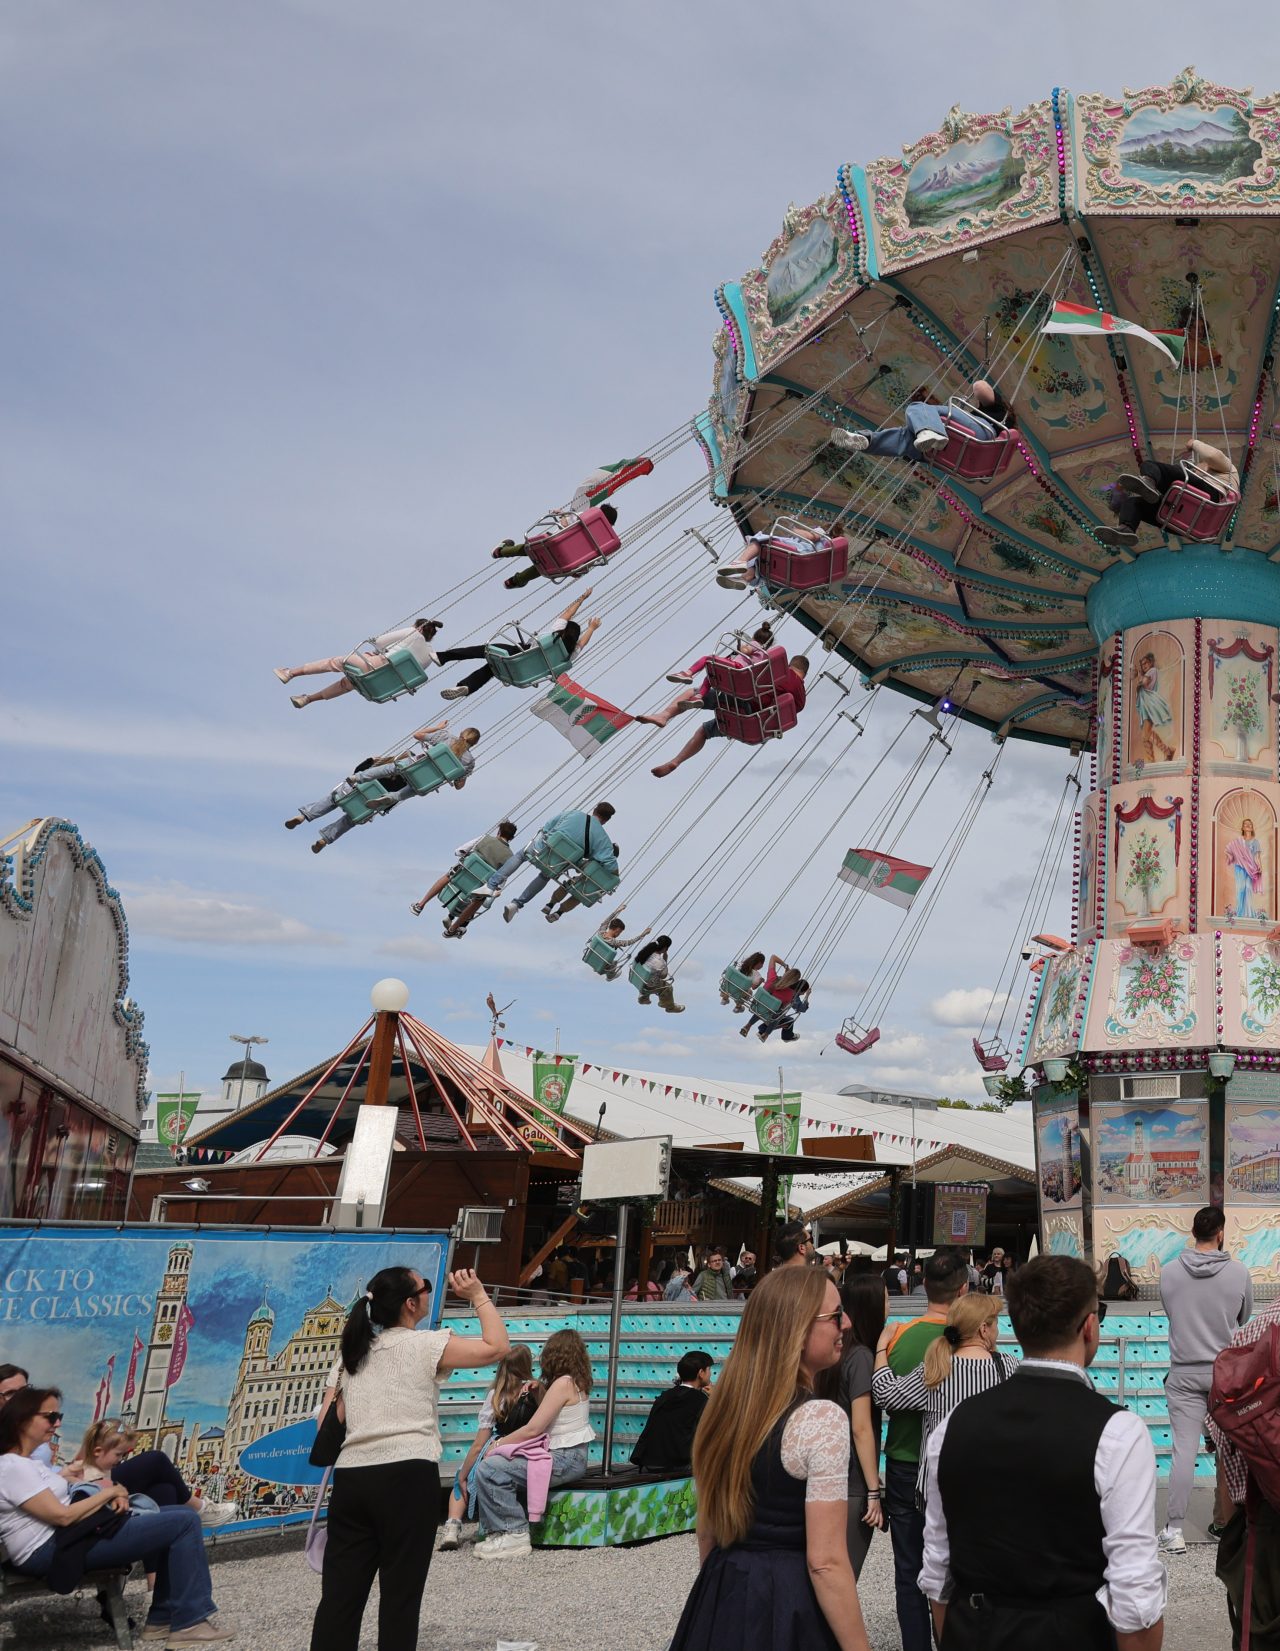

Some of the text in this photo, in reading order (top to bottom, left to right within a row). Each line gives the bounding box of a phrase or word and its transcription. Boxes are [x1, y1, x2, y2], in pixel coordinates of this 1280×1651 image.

[0, 1268, 94, 1292] CK TO
[30, 1294, 152, 1320] CLASSICS
